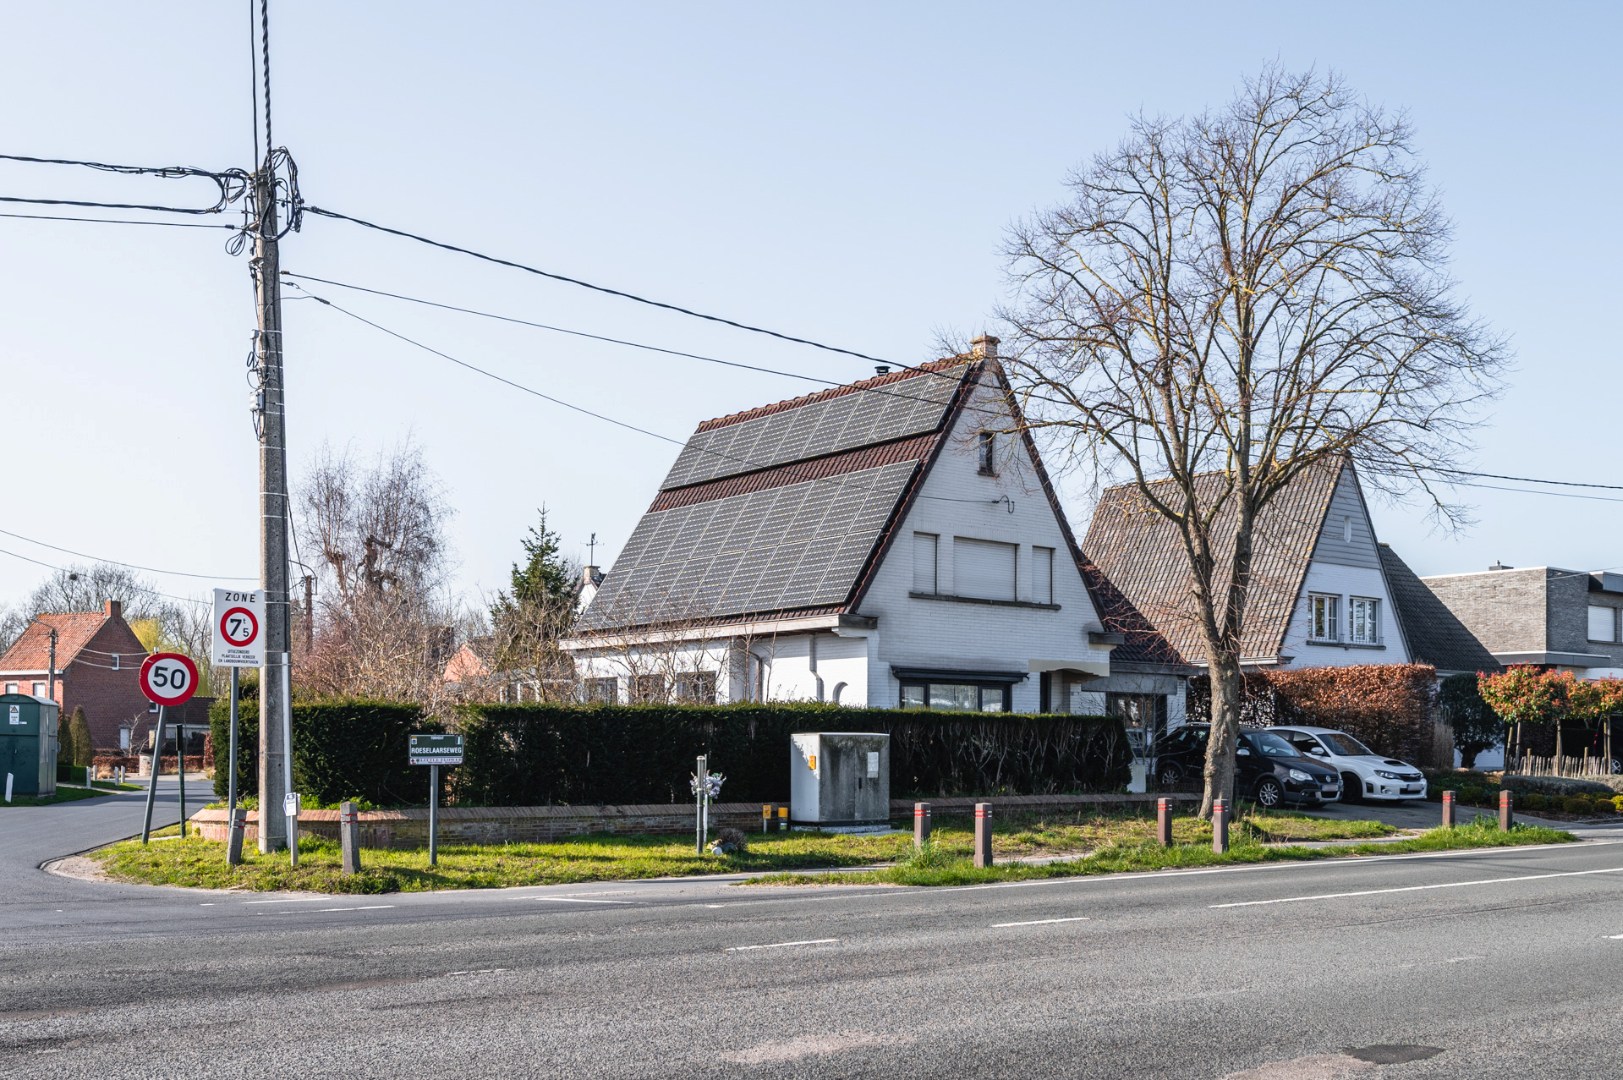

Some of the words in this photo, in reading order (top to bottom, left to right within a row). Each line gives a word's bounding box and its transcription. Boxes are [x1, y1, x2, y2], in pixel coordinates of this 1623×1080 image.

[225, 592, 256, 603] ZONE
[152, 665, 186, 690] 50
[411, 746, 462, 754] ROESELAARSEWEG
